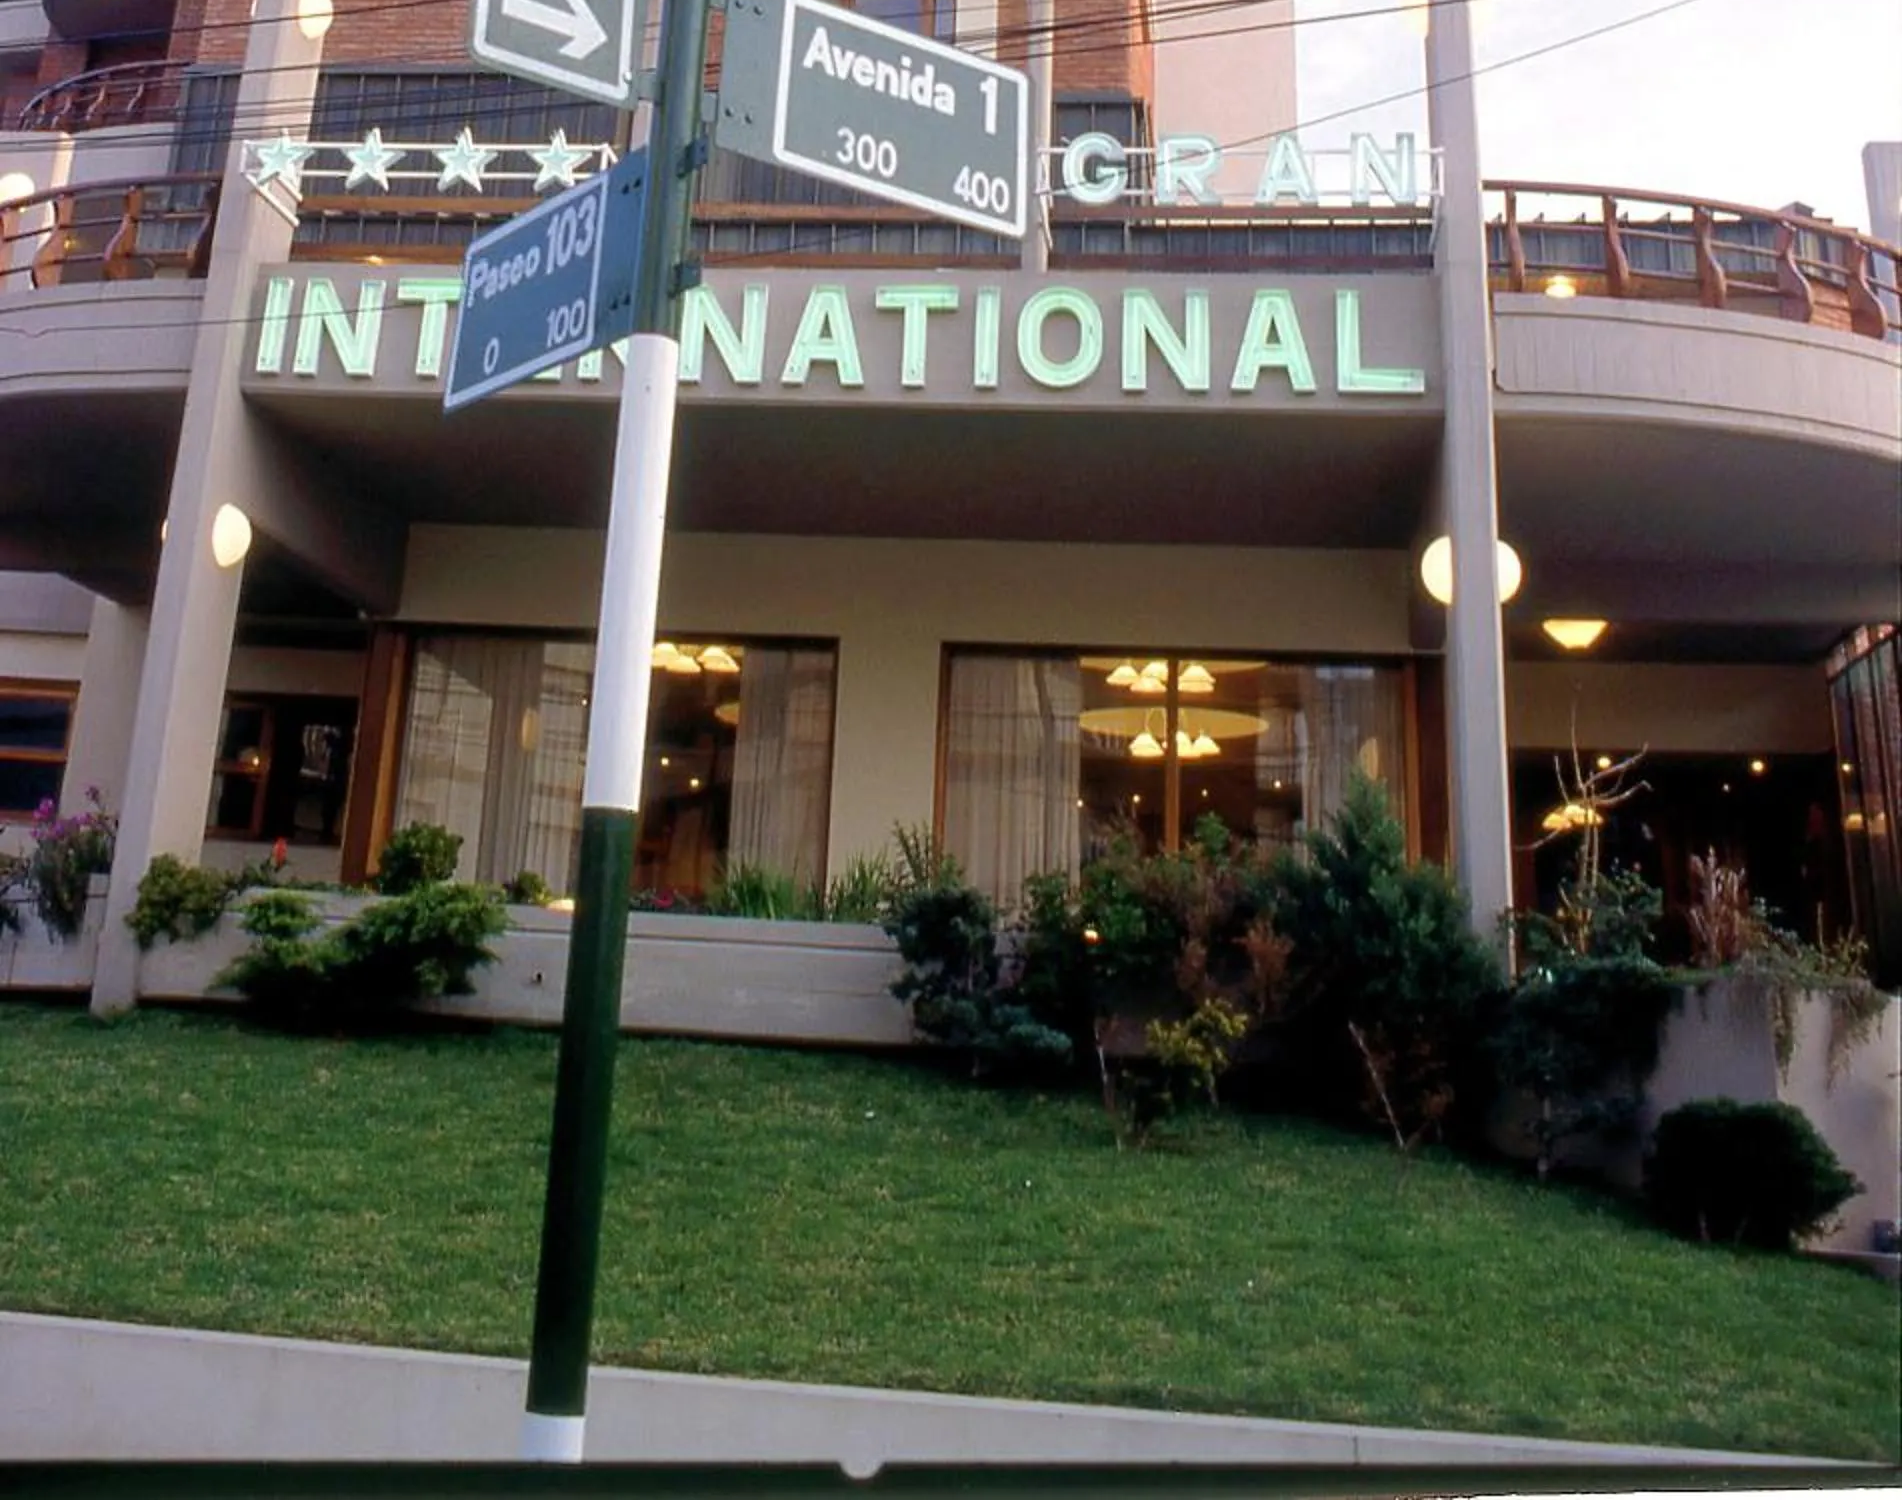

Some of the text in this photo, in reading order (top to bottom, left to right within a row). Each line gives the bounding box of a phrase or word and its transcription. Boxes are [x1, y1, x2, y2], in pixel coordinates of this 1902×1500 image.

[803, 26, 998, 136] Avenida 1
[836, 127, 1010, 214] 300 400
[1062, 131, 1415, 206] GRAN
[467, 195, 597, 308] Paseo 103
[256, 277, 1426, 394] INTNATIONAL
[483, 299, 586, 376] 0 100
